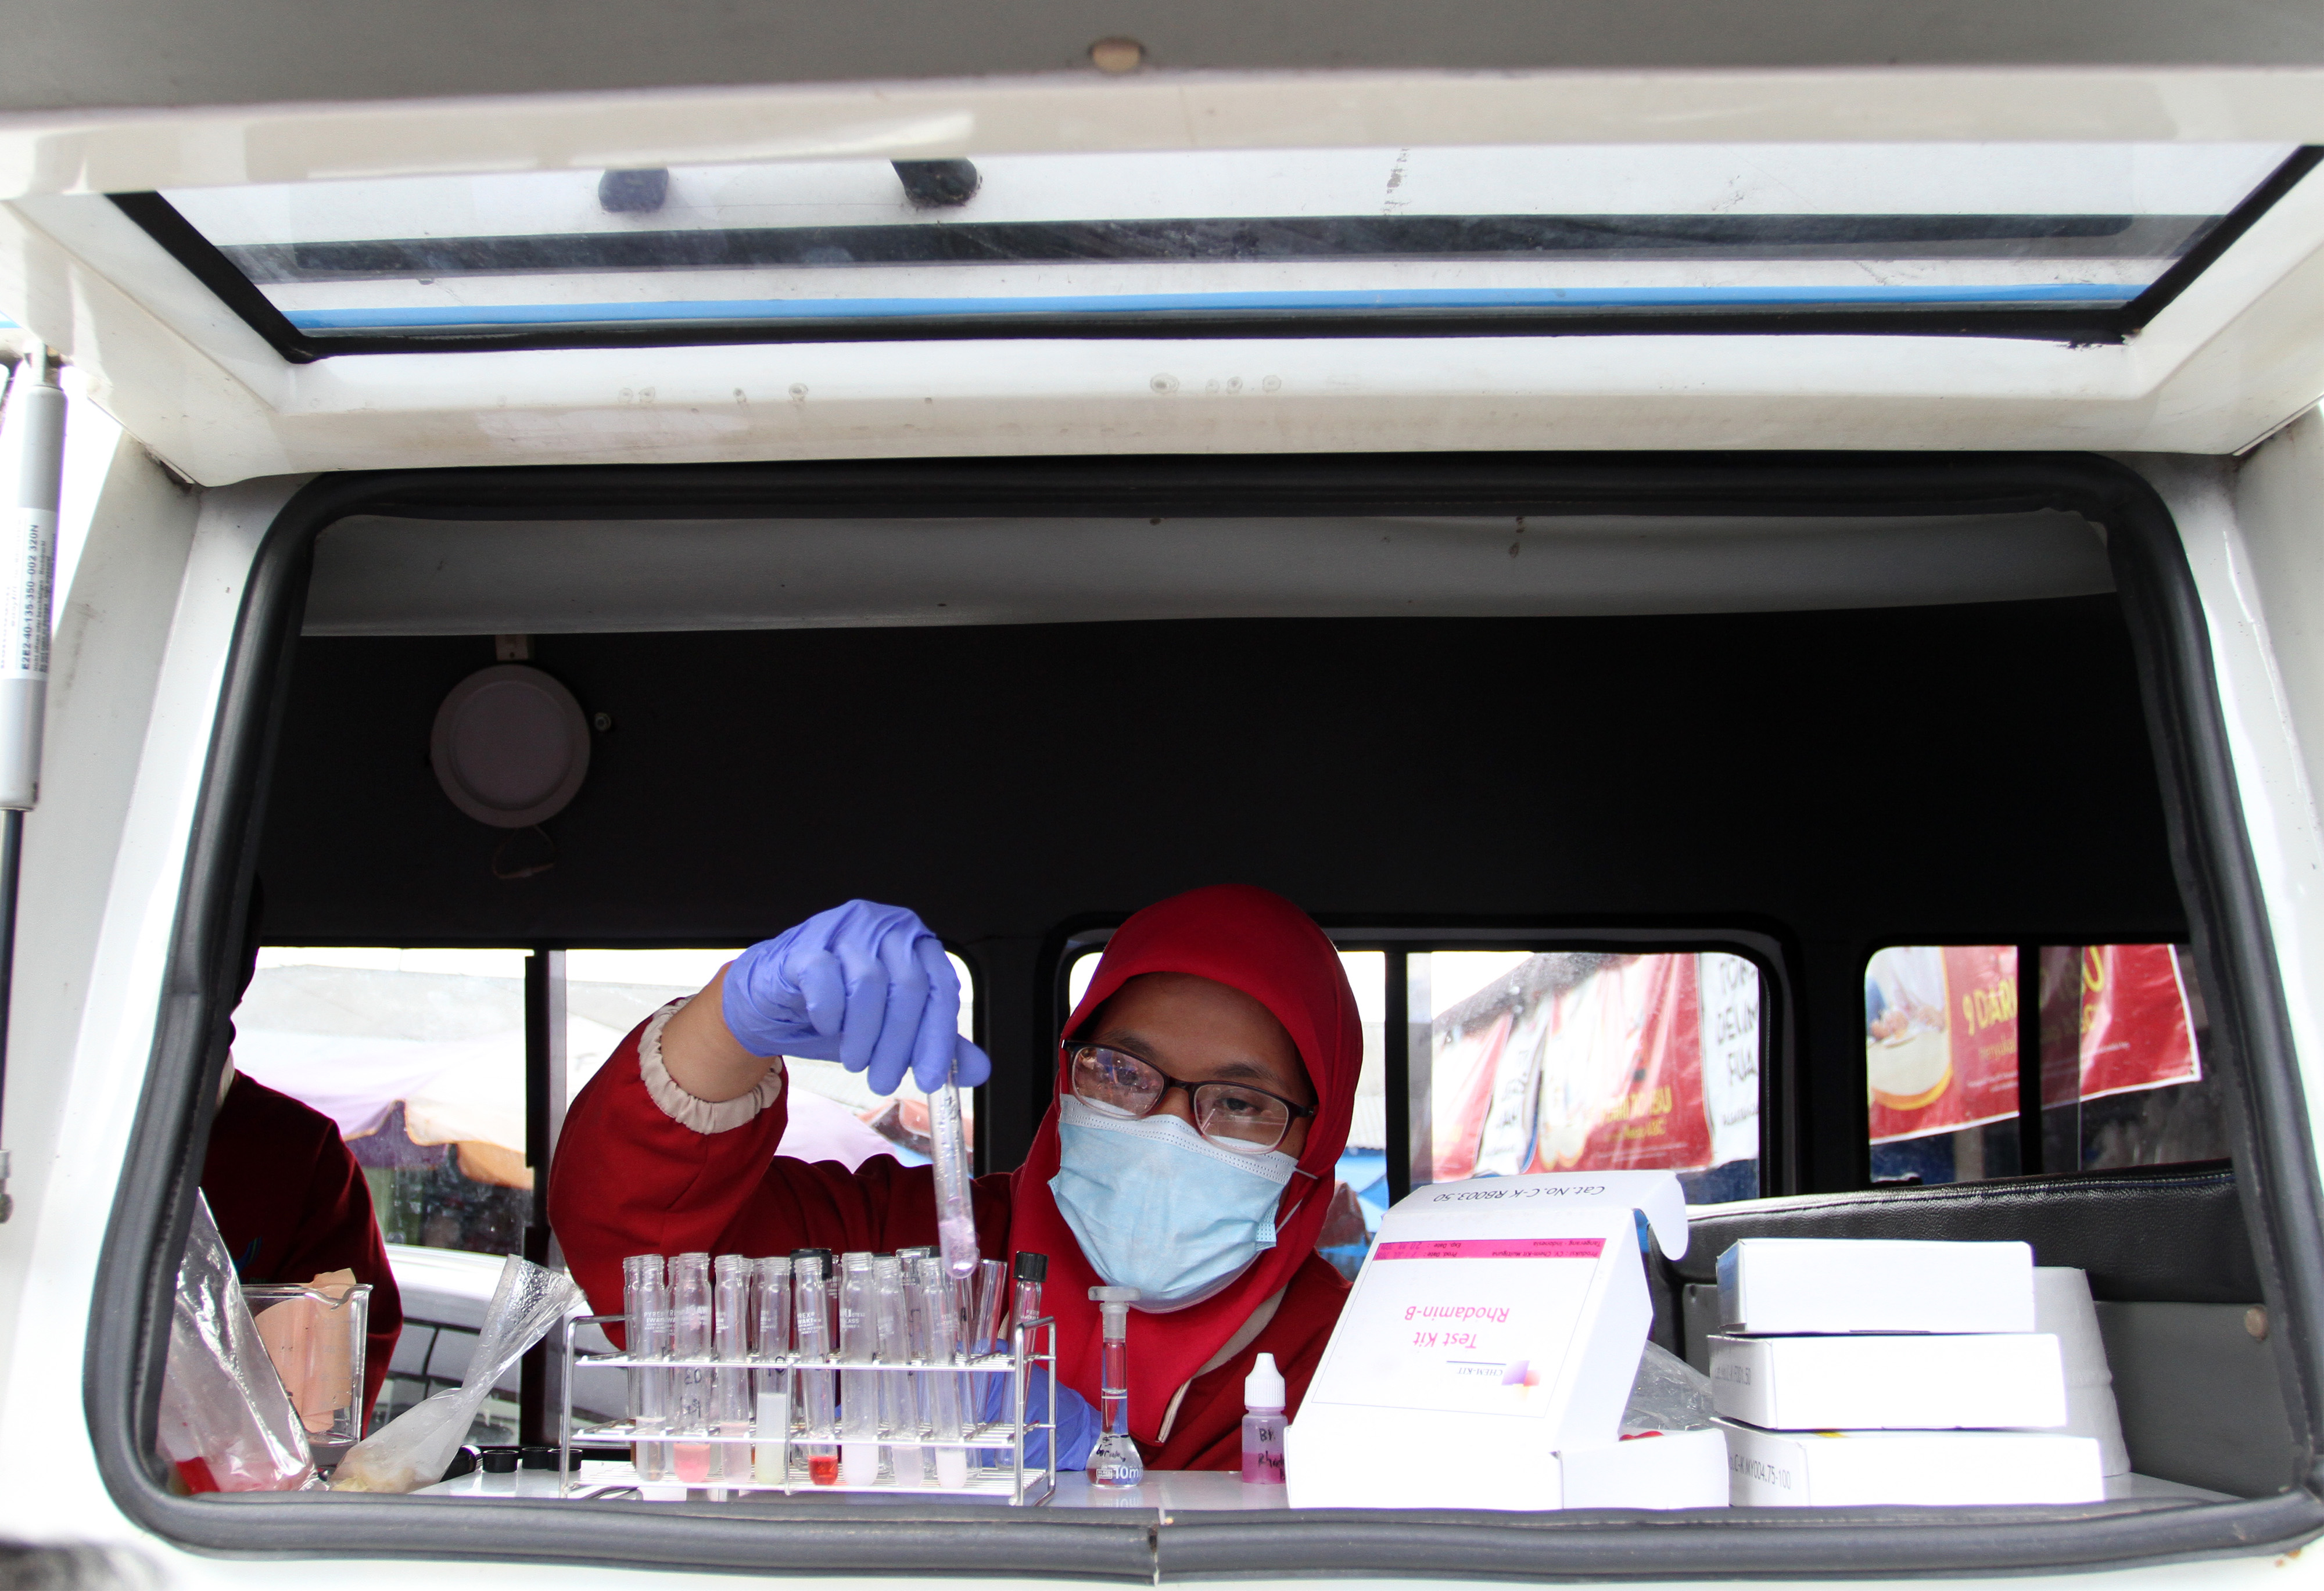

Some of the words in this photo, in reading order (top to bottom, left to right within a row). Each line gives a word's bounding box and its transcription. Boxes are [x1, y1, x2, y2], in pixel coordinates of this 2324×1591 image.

[28, 525, 39, 552] 320N
[1405, 1305, 1511, 1323] Rhodamin-B
[1412, 1331, 1439, 1348] Kit
[1443, 1331, 1479, 1349] Test
[1457, 1366, 1504, 1377] CHEM-KIT
